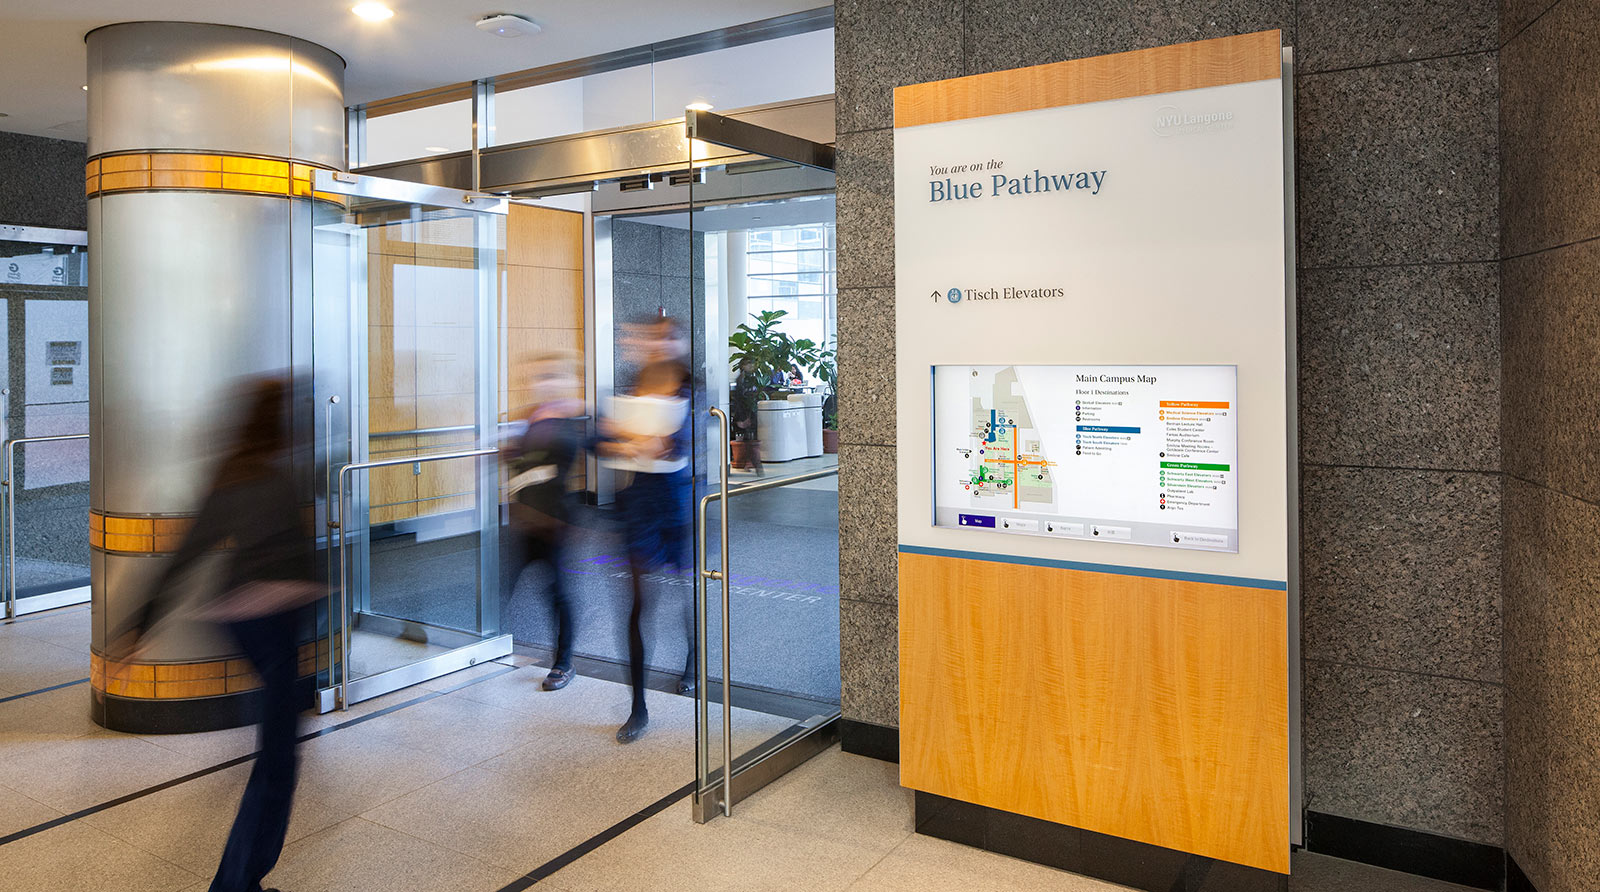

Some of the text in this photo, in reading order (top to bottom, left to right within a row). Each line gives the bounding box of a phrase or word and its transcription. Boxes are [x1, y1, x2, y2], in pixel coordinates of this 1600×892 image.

[1157, 111, 1233, 128] NYU Langone
[929, 159, 1004, 176] You are on the
[929, 169, 1107, 202] Blue Pathway
[964, 286, 1064, 301] Tisch Elevators
[1075, 374, 1157, 385] Main Campus Map
